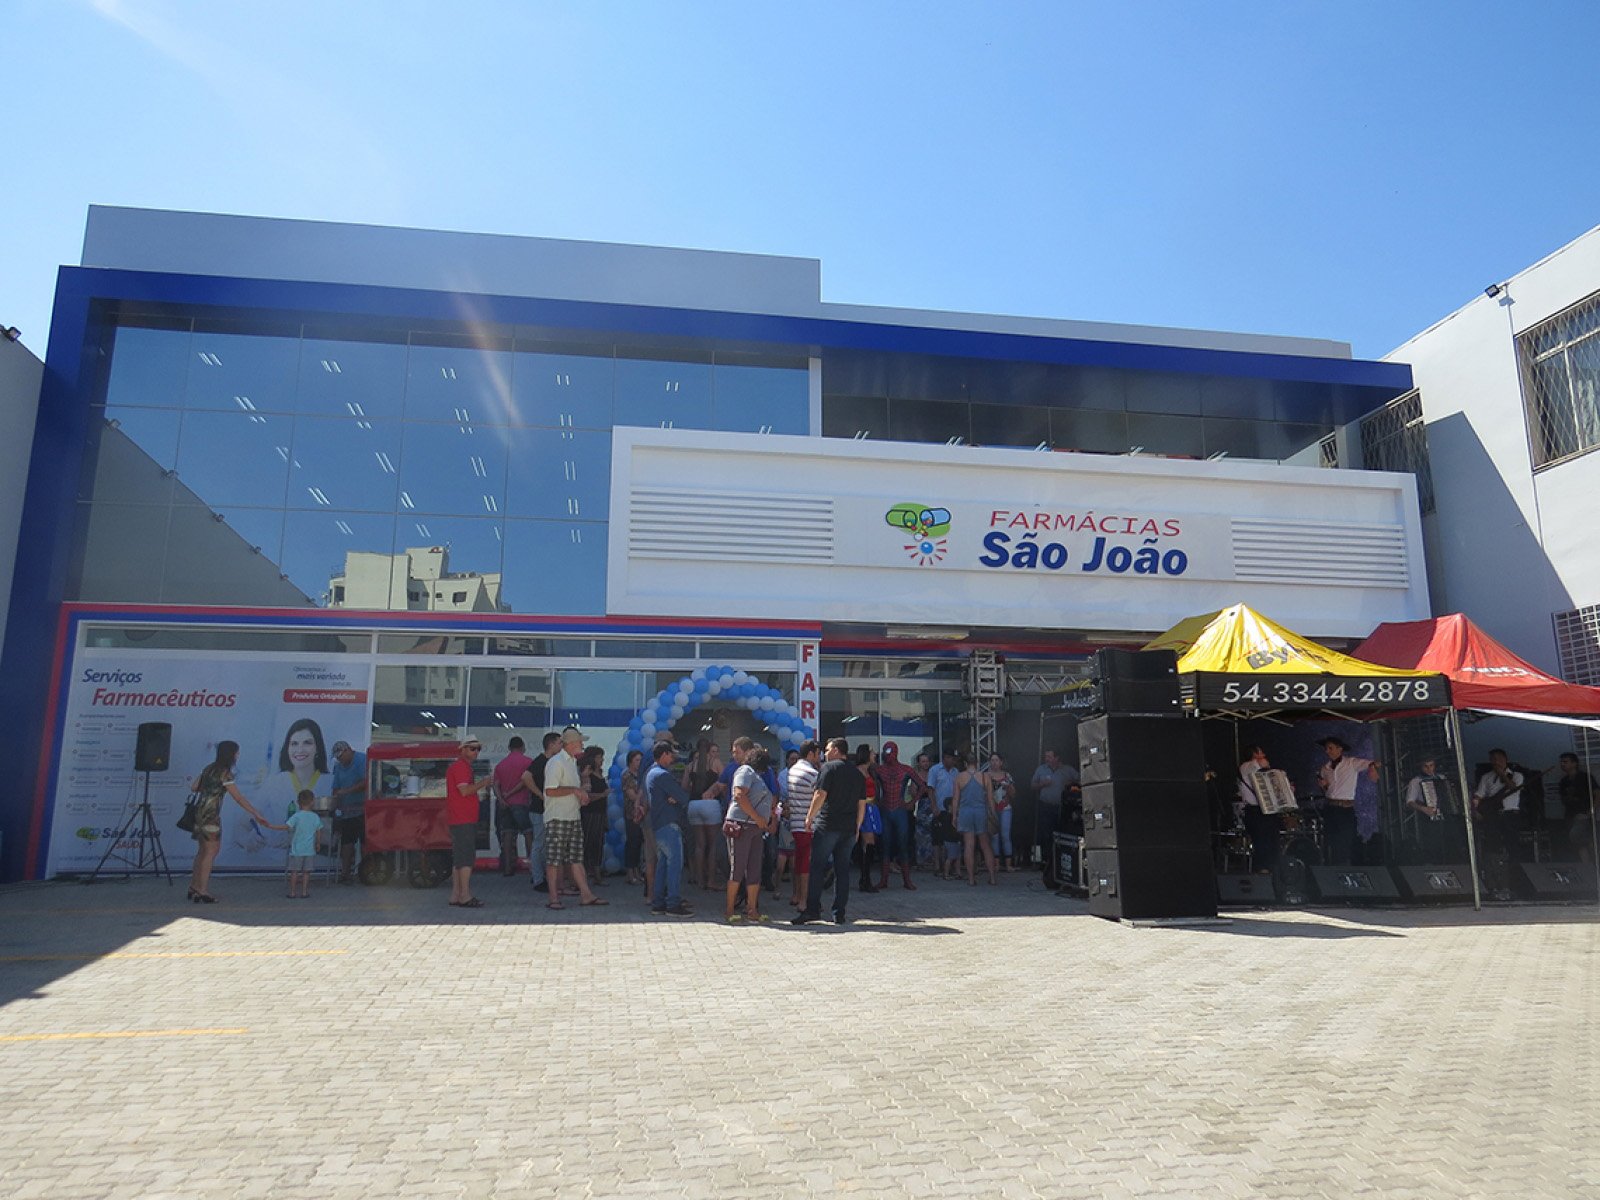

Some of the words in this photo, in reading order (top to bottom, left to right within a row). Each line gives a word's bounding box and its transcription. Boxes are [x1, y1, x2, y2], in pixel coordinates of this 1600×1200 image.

[991, 511, 1180, 536] FARMÁCIAS
[979, 531, 1069, 570] São
[1081, 536, 1188, 575] João
[82, 668, 143, 687] Serviços
[92, 688, 237, 707] Farmacêuticos
[1223, 681, 1430, 703] 54.3344.2878
